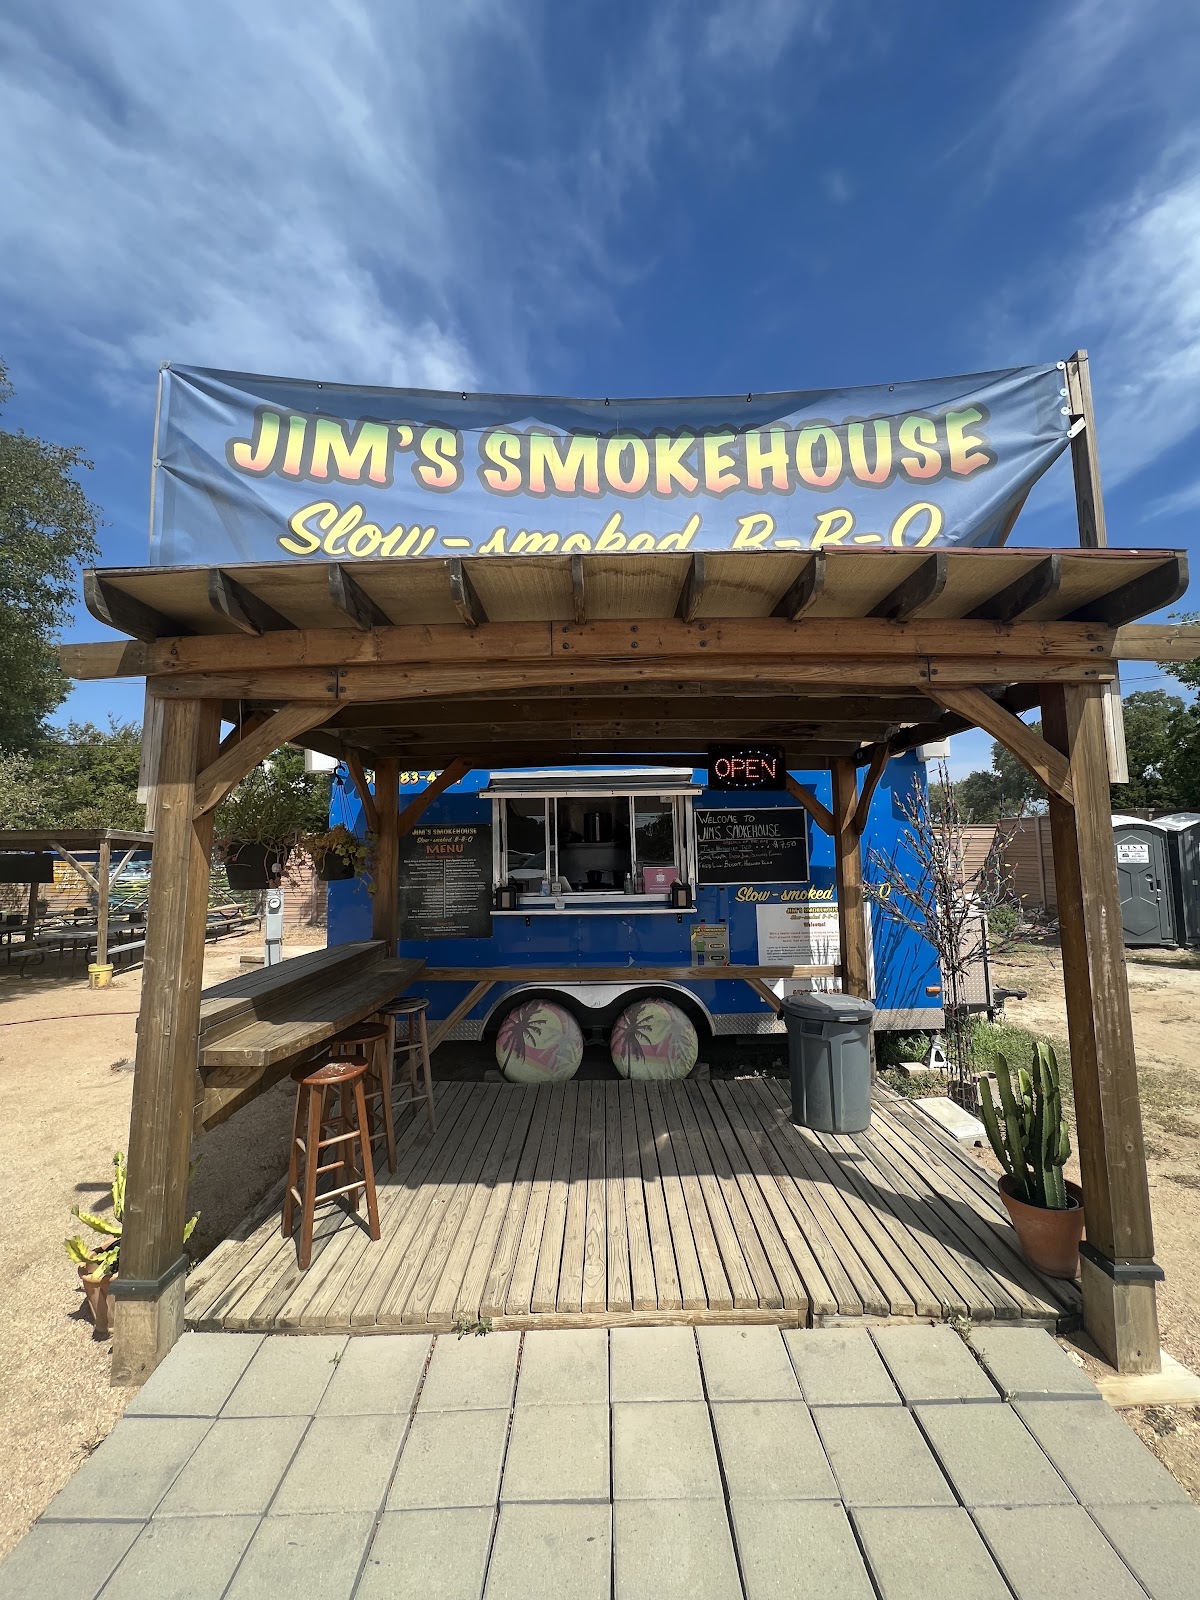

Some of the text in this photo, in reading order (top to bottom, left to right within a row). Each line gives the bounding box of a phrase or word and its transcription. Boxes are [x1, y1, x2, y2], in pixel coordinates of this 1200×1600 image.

[230, 405, 994, 494] JIM'S SMOKEHOUSE
[714, 758, 777, 778] OPEN
[697, 811, 738, 824] WELCOME
[432, 827, 478, 835] SMOKEHOUSE
[726, 823, 781, 840] SMOKEHOUSE
[426, 844, 464, 854] MENU
